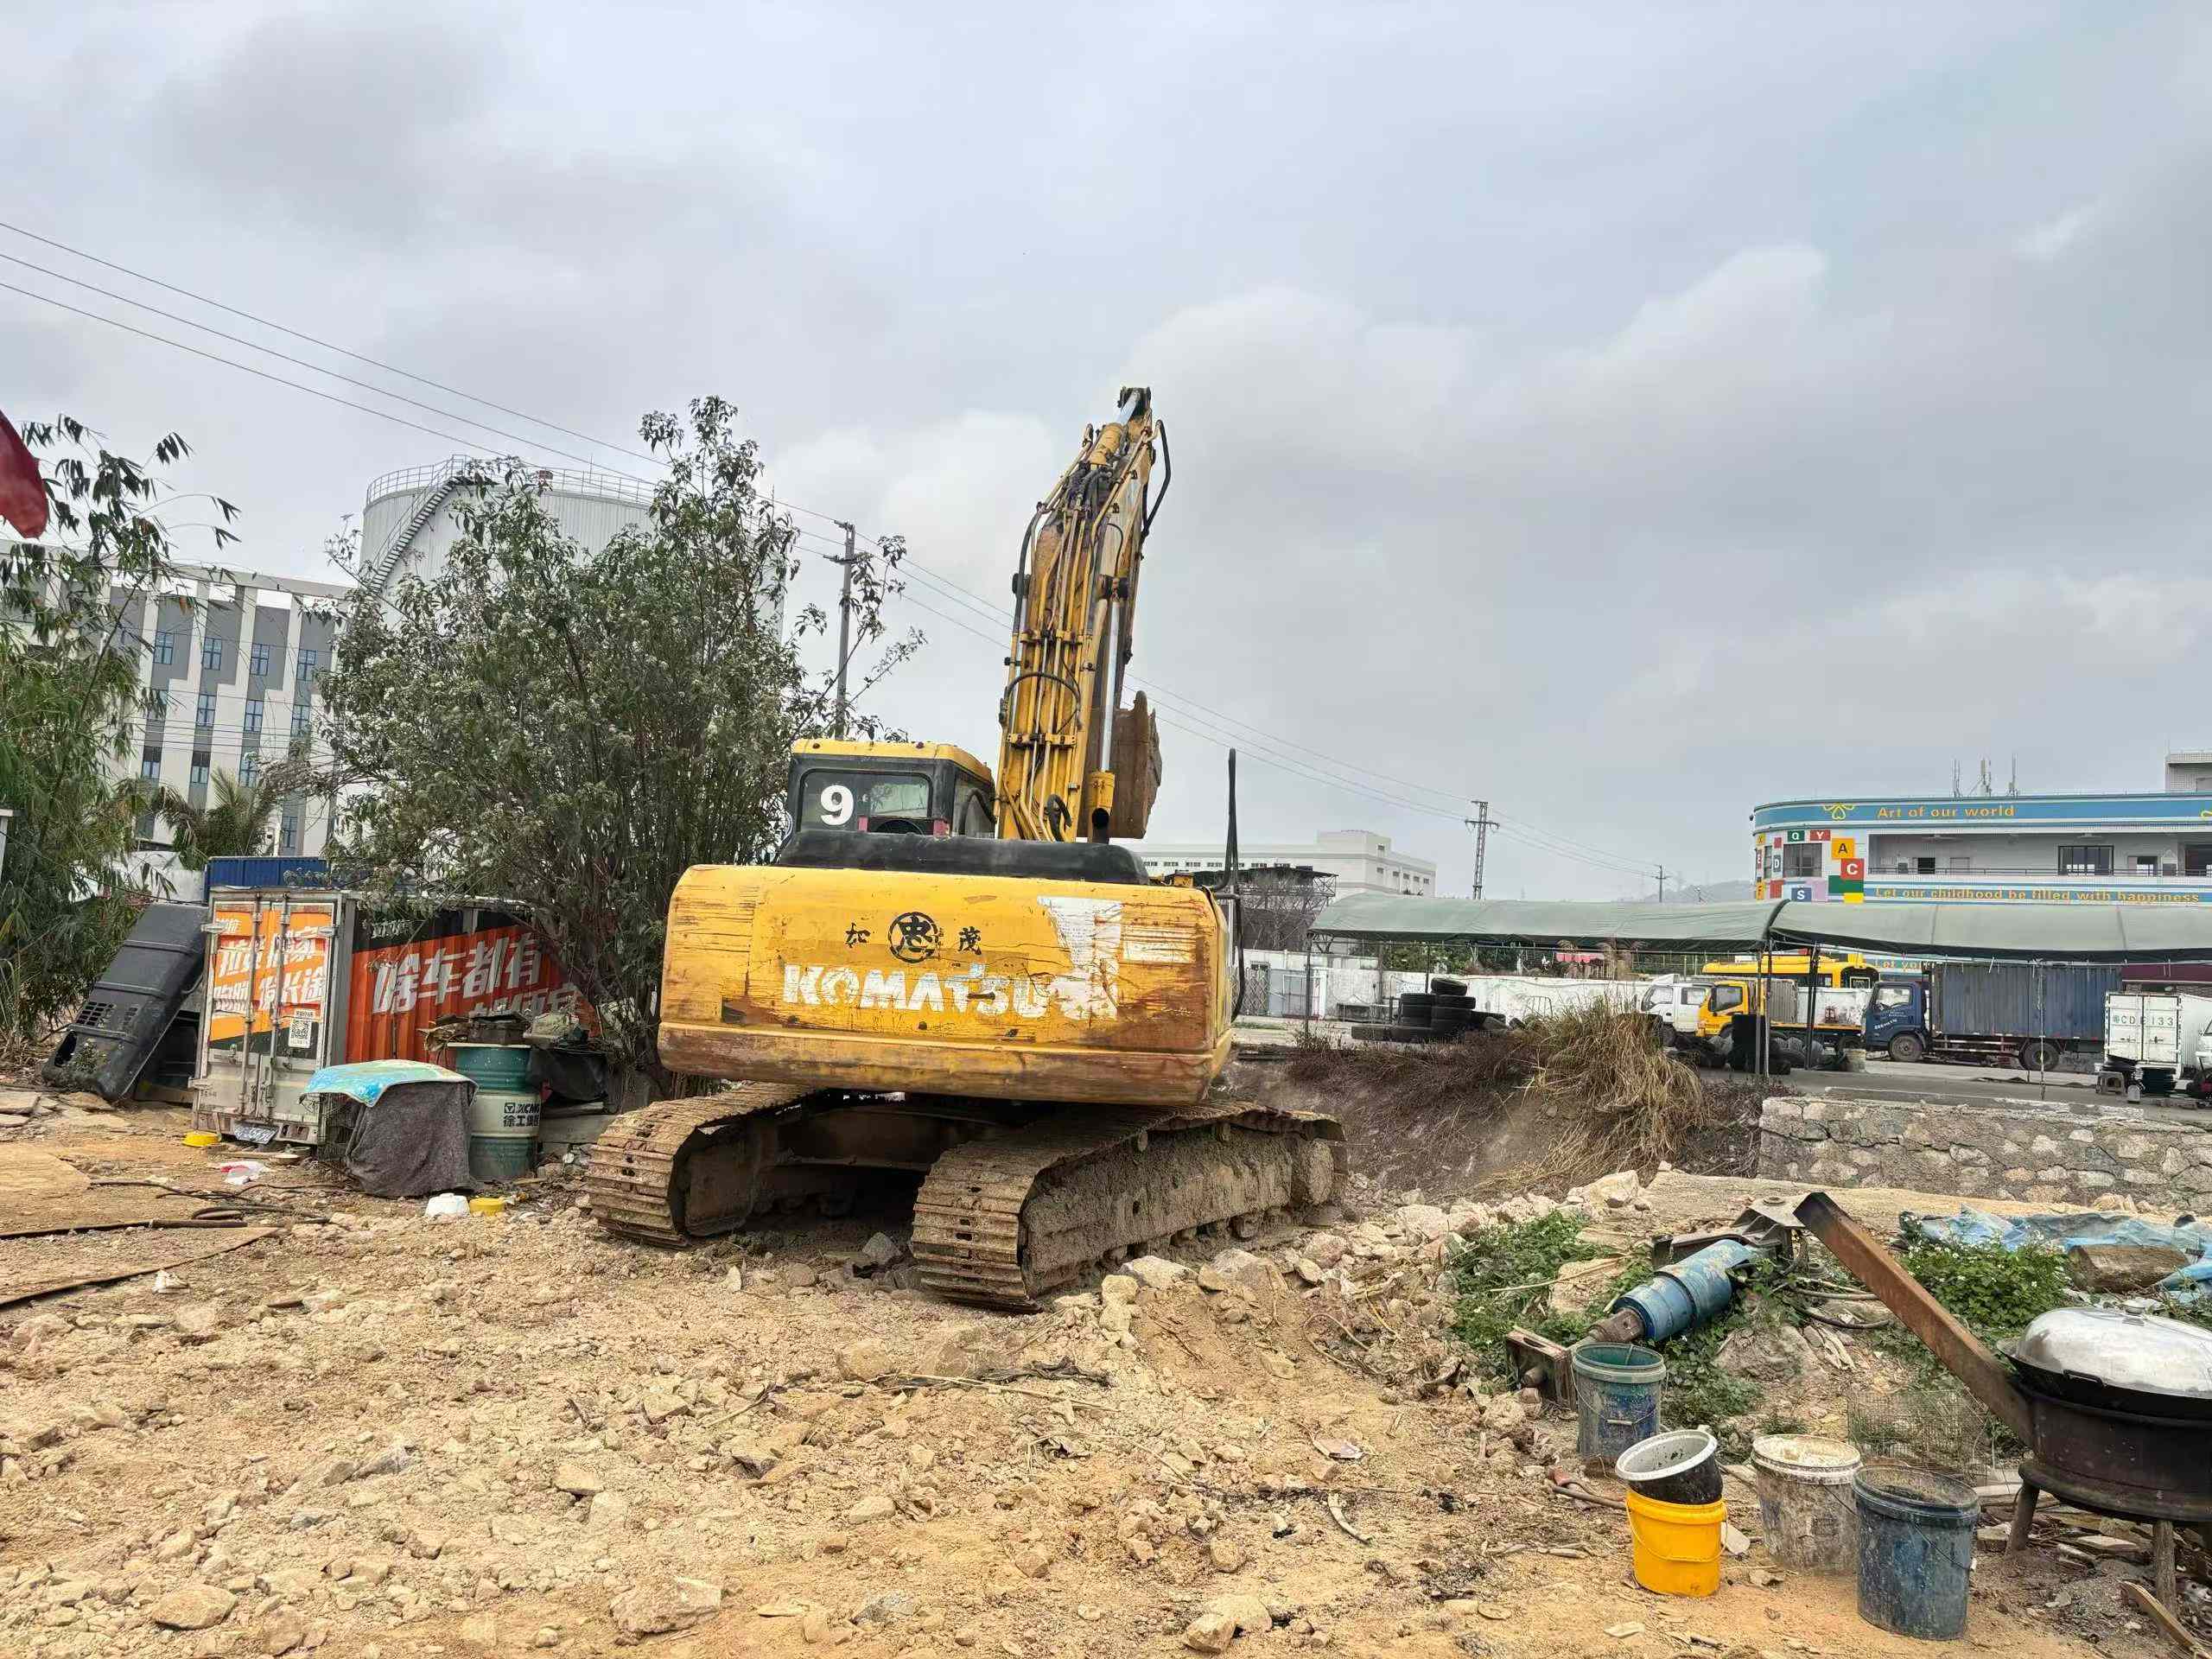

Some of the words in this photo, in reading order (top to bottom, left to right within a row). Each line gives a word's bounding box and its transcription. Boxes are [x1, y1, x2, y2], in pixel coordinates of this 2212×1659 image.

[820, 785, 854, 826] 9
[1877, 806, 1901, 817] Art
[1908, 805, 1925, 817] of
[1930, 807, 1957, 817] our
[1964, 804, 2015, 817] world
[1791, 832, 1800, 842] Q
[1816, 831, 1825, 841] Y
[1838, 842, 1848, 854] A
[1847, 863, 1859, 875] C
[1797, 890, 1805, 900] S
[1874, 887, 1897, 899] Let
[1902, 888, 1925, 899] our
[1931, 887, 2003, 899] childhood
[2008, 889, 2026, 899] be
[2031, 889, 2071, 901] filled
[2075, 890, 2111, 901] with
[2117, 891, 2200, 904] happiness
[372, 931, 542, 1015] 啥车都有
[784, 963, 1051, 1018] KOMATSU
